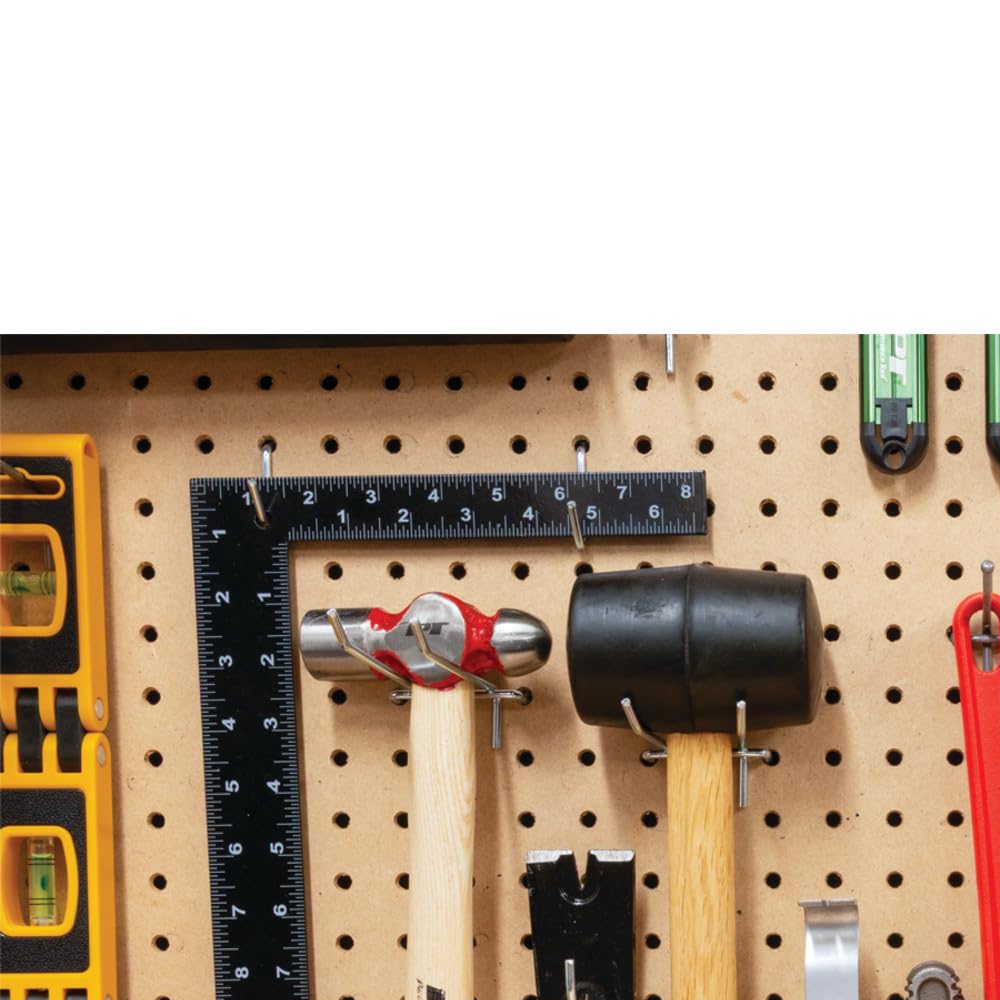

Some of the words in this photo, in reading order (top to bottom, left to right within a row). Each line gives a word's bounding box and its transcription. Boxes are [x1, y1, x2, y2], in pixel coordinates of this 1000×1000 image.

[243, 491, 251, 505] 1
[304, 491, 313, 504] 2
[366, 490, 376, 503] 3
[428, 489, 439, 502] 4
[492, 488, 502, 501] 5
[555, 487, 565, 500] 6
[617, 486, 627, 499] 7
[681, 484, 691, 498] 8
[337, 510, 345, 523] 1
[399, 509, 408, 522] 2
[461, 508, 471, 521] 3
[523, 507, 534, 520] 4
[587, 506, 597, 519] 5
[649, 505, 659, 518] 6
[212, 530, 226, 539] 1
[216, 592, 229, 603] 2
[258, 593, 271, 602] 1
[219, 655, 232, 666] 3
[261, 655, 274, 665] 2
[222, 718, 235, 730] 4
[264, 718, 277, 728] 3
[226, 781, 239, 792] 5
[267, 780, 280, 793] 4
[229, 843, 242, 854] 6
[270, 843, 283, 853] 5
[232, 906, 246, 917] 7
[273, 905, 287, 916] 6
[235, 967, 248, 978] 8
[276, 967, 290, 978] 7
